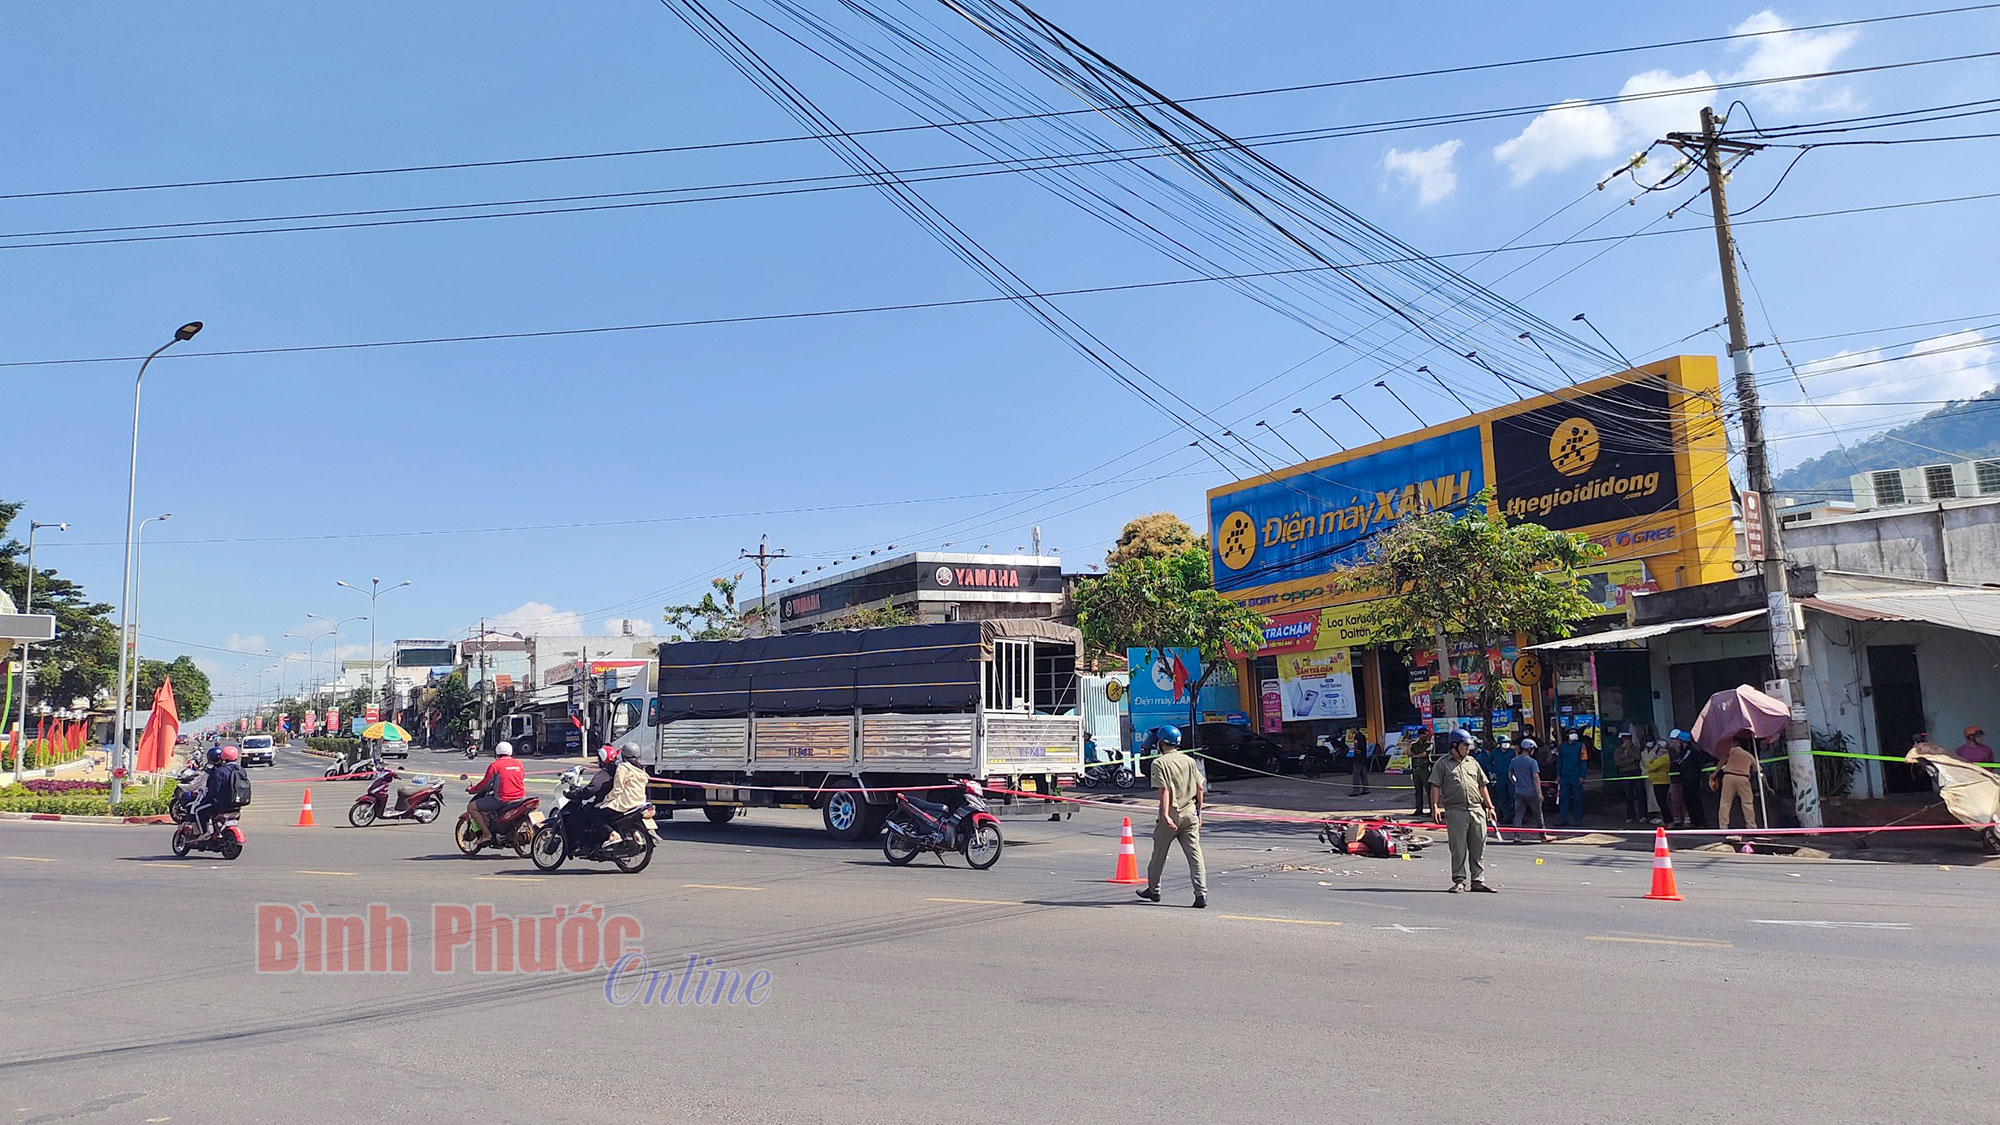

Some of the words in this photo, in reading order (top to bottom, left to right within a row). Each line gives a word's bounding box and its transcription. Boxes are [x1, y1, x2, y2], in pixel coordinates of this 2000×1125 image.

[1506, 471, 1660, 516] thegioididong
[1261, 512, 1315, 549] Điện
[1319, 496, 1376, 534] máy
[1372, 470, 1470, 524] XANH
[1631, 525, 1676, 544] GREE
[955, 568, 1019, 587] YAMAHA
[1248, 593, 1278, 607] SONY
[1327, 618, 1343, 628] Loa
[1345, 611, 1384, 626] Karaok
[1266, 624, 1282, 639] TRẢ
[1283, 621, 1312, 638] CHẬM
[1340, 626, 1371, 640] Dalton
[1134, 696, 1154, 707] Điện
[1154, 695, 1172, 706] máy
